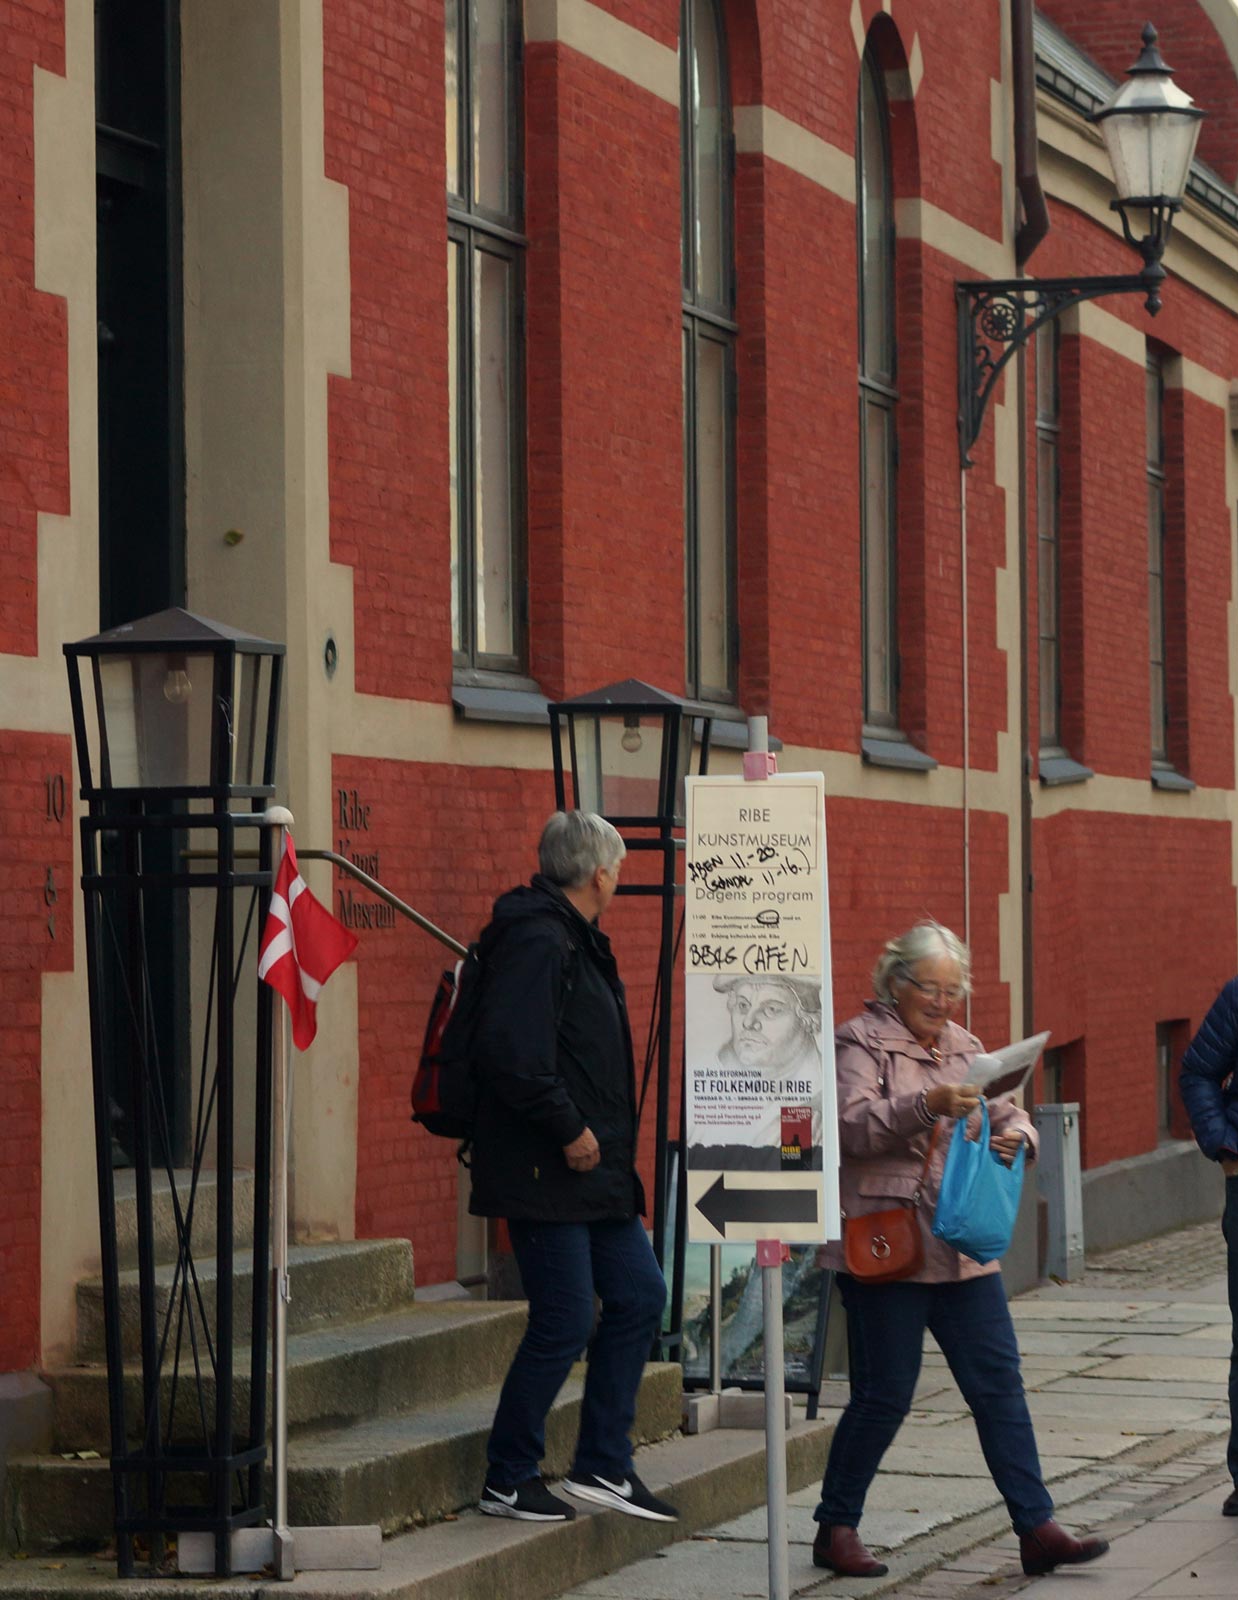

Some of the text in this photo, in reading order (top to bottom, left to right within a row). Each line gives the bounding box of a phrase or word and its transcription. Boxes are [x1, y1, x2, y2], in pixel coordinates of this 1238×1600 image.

[44, 773, 67, 822] 10
[338, 789, 371, 831] Ribe
[739, 808, 771, 822] RIBE
[698, 833, 811, 847] KUNSTMUSEUM
[695, 887, 813, 904] Dagens program
[338, 888, 397, 929] Museum
[706, 1067, 718, 1078] ÅRS
[719, 1070, 762, 1078] REFORMATION
[694, 1080, 812, 1094] ET FOLKEMØDE I RIBE
